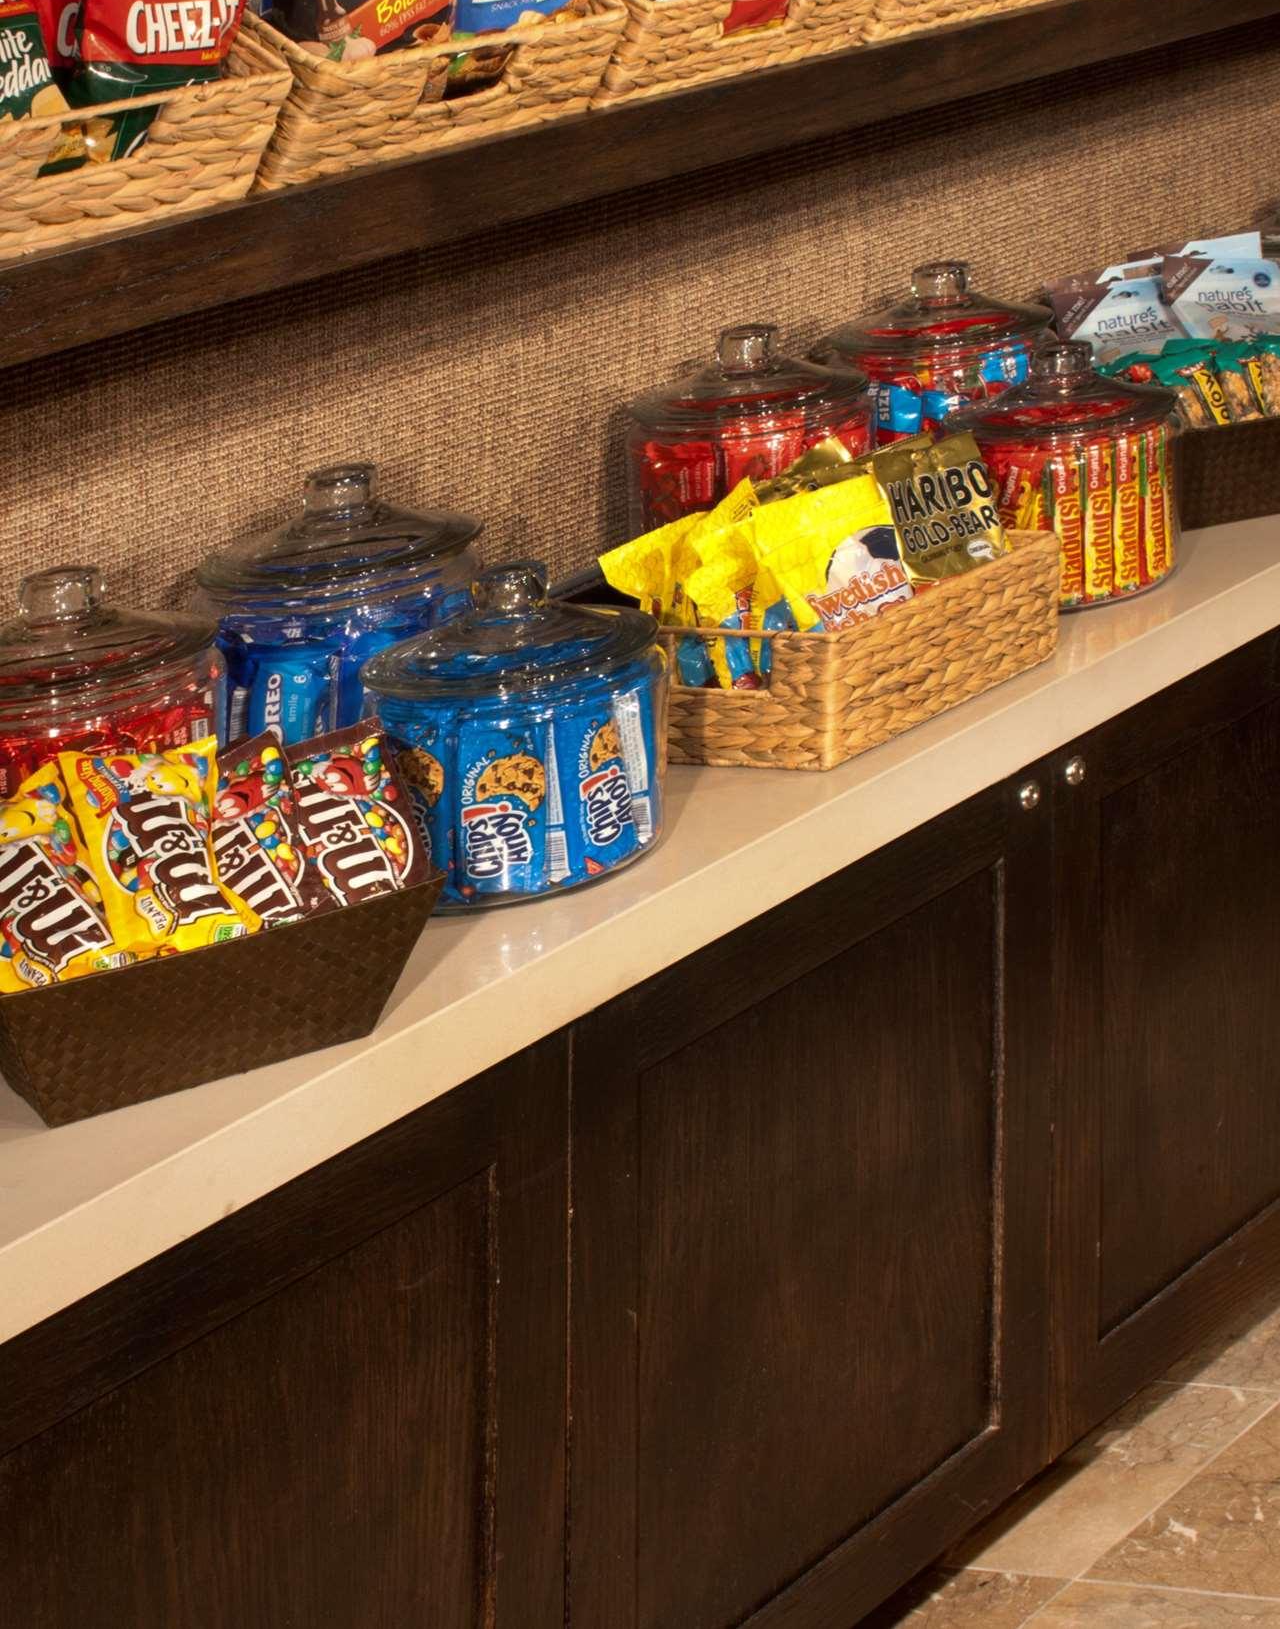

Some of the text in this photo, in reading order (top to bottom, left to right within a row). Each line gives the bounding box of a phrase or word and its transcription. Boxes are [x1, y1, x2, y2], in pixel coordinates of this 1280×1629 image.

[1098, 308, 1157, 332] nature's
[1197, 287, 1252, 302] nature's
[887, 461, 993, 523] HARIBO
[1090, 445, 1100, 488] Original
[902, 508, 999, 554] GOLD-BEAR
[1089, 492, 1112, 588] Starburst
[1118, 486, 1138, 583] Starburst
[806, 562, 907, 618] Swedish
[579, 727, 597, 778] ORIGINAL
[461, 755, 491, 804] ORIGINAL
[587, 787, 623, 845] CHIPS
[467, 818, 506, 878] CHIPS
[140, 895, 167, 932] PEANUT
